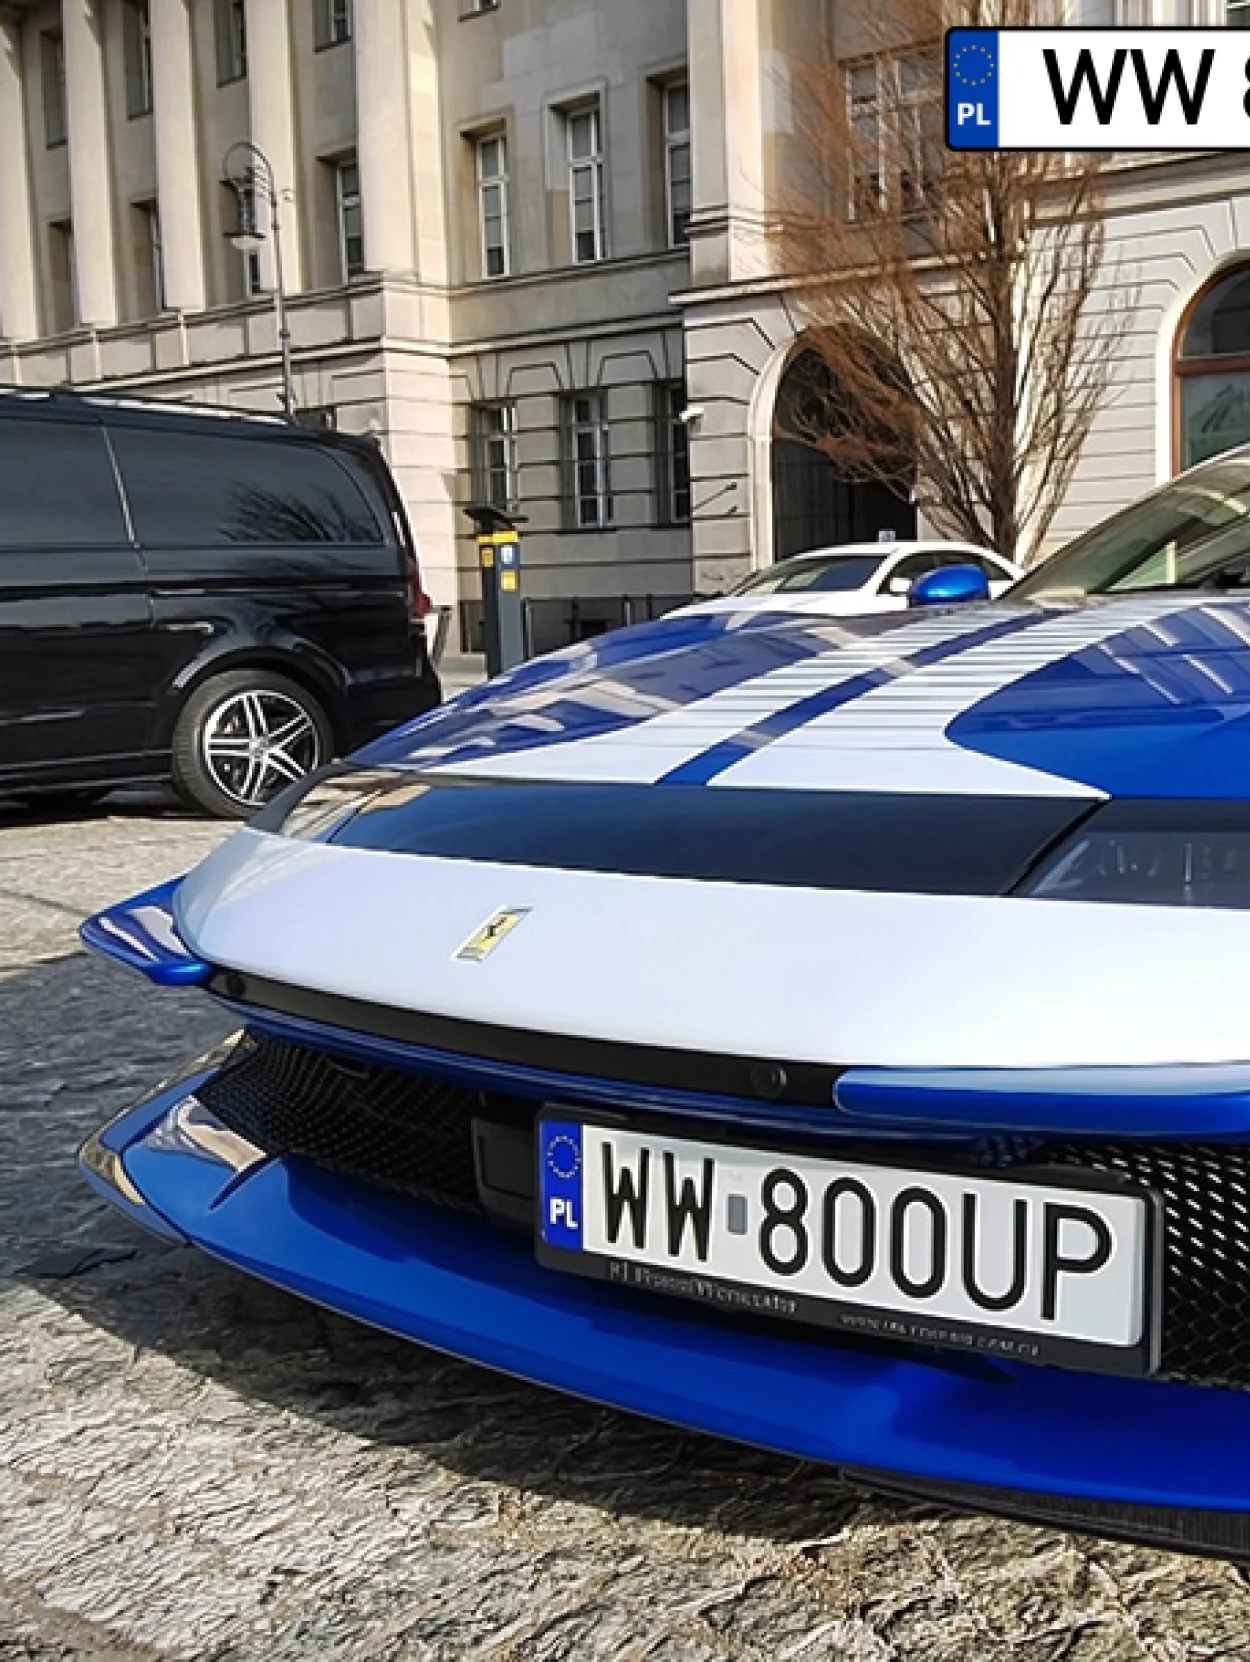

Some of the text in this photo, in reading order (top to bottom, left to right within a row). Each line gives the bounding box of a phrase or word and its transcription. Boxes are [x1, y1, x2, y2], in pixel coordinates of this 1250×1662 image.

[549, 1198, 579, 1229] PL
[602, 1141, 1112, 1320] WW 800UP
